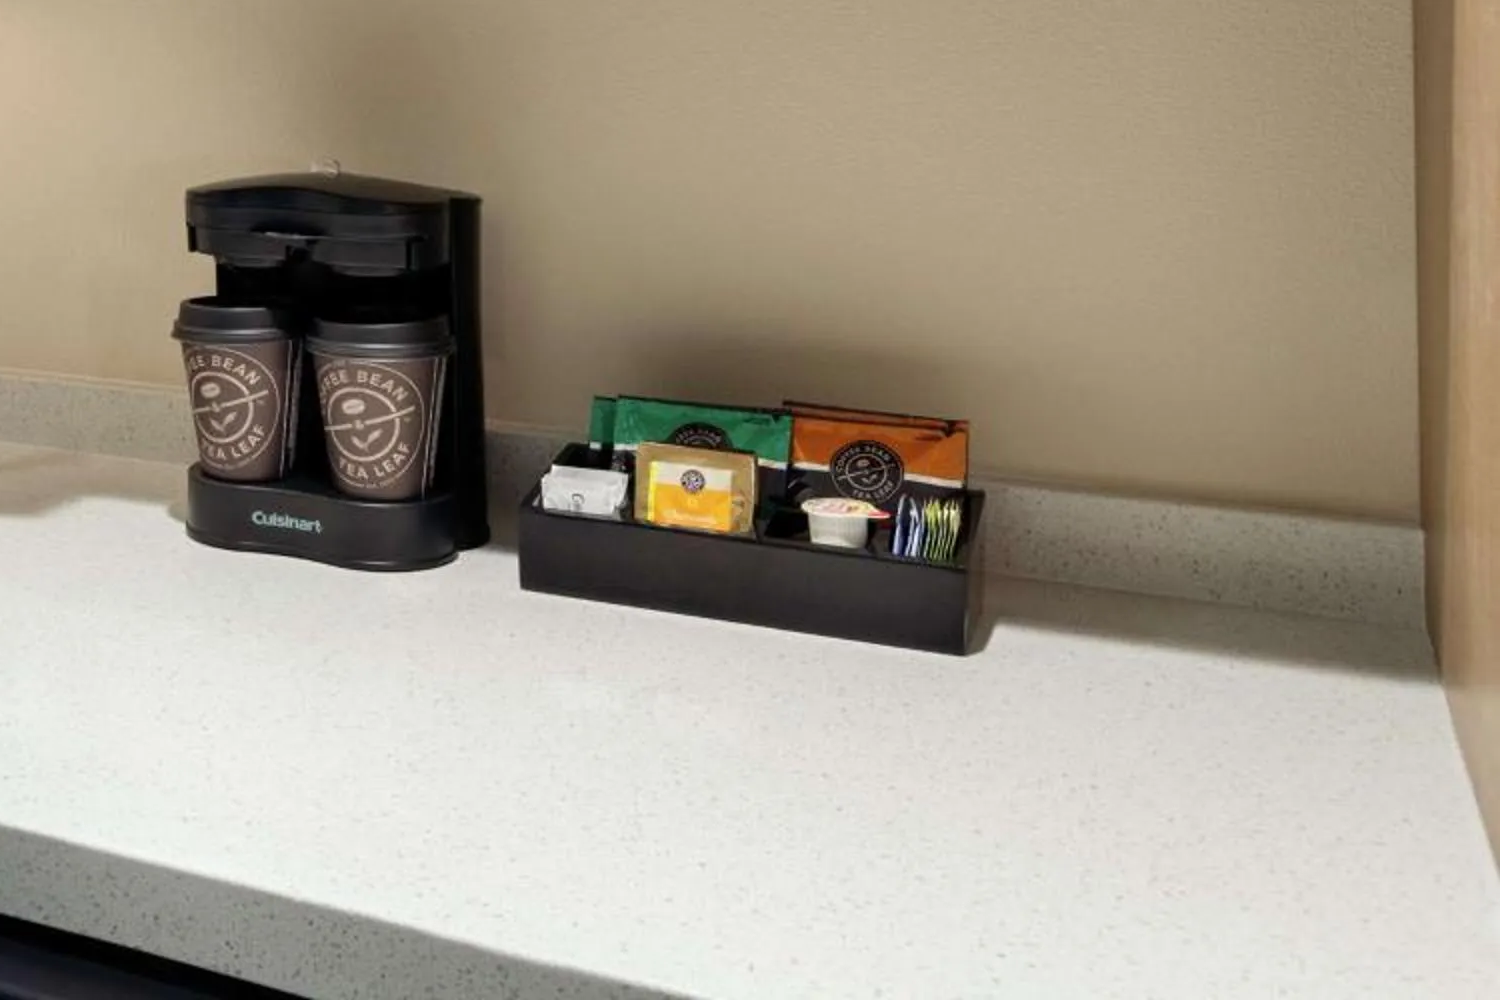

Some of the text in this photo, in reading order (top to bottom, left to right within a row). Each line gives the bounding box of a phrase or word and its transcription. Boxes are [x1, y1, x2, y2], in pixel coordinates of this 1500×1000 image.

[211, 355, 260, 385] BEAN
[357, 369, 409, 401] BEAN
[230, 425, 265, 459] LEAF
[339, 441, 410, 480] TEA LEAF
[251, 510, 322, 534] Cuisinart
